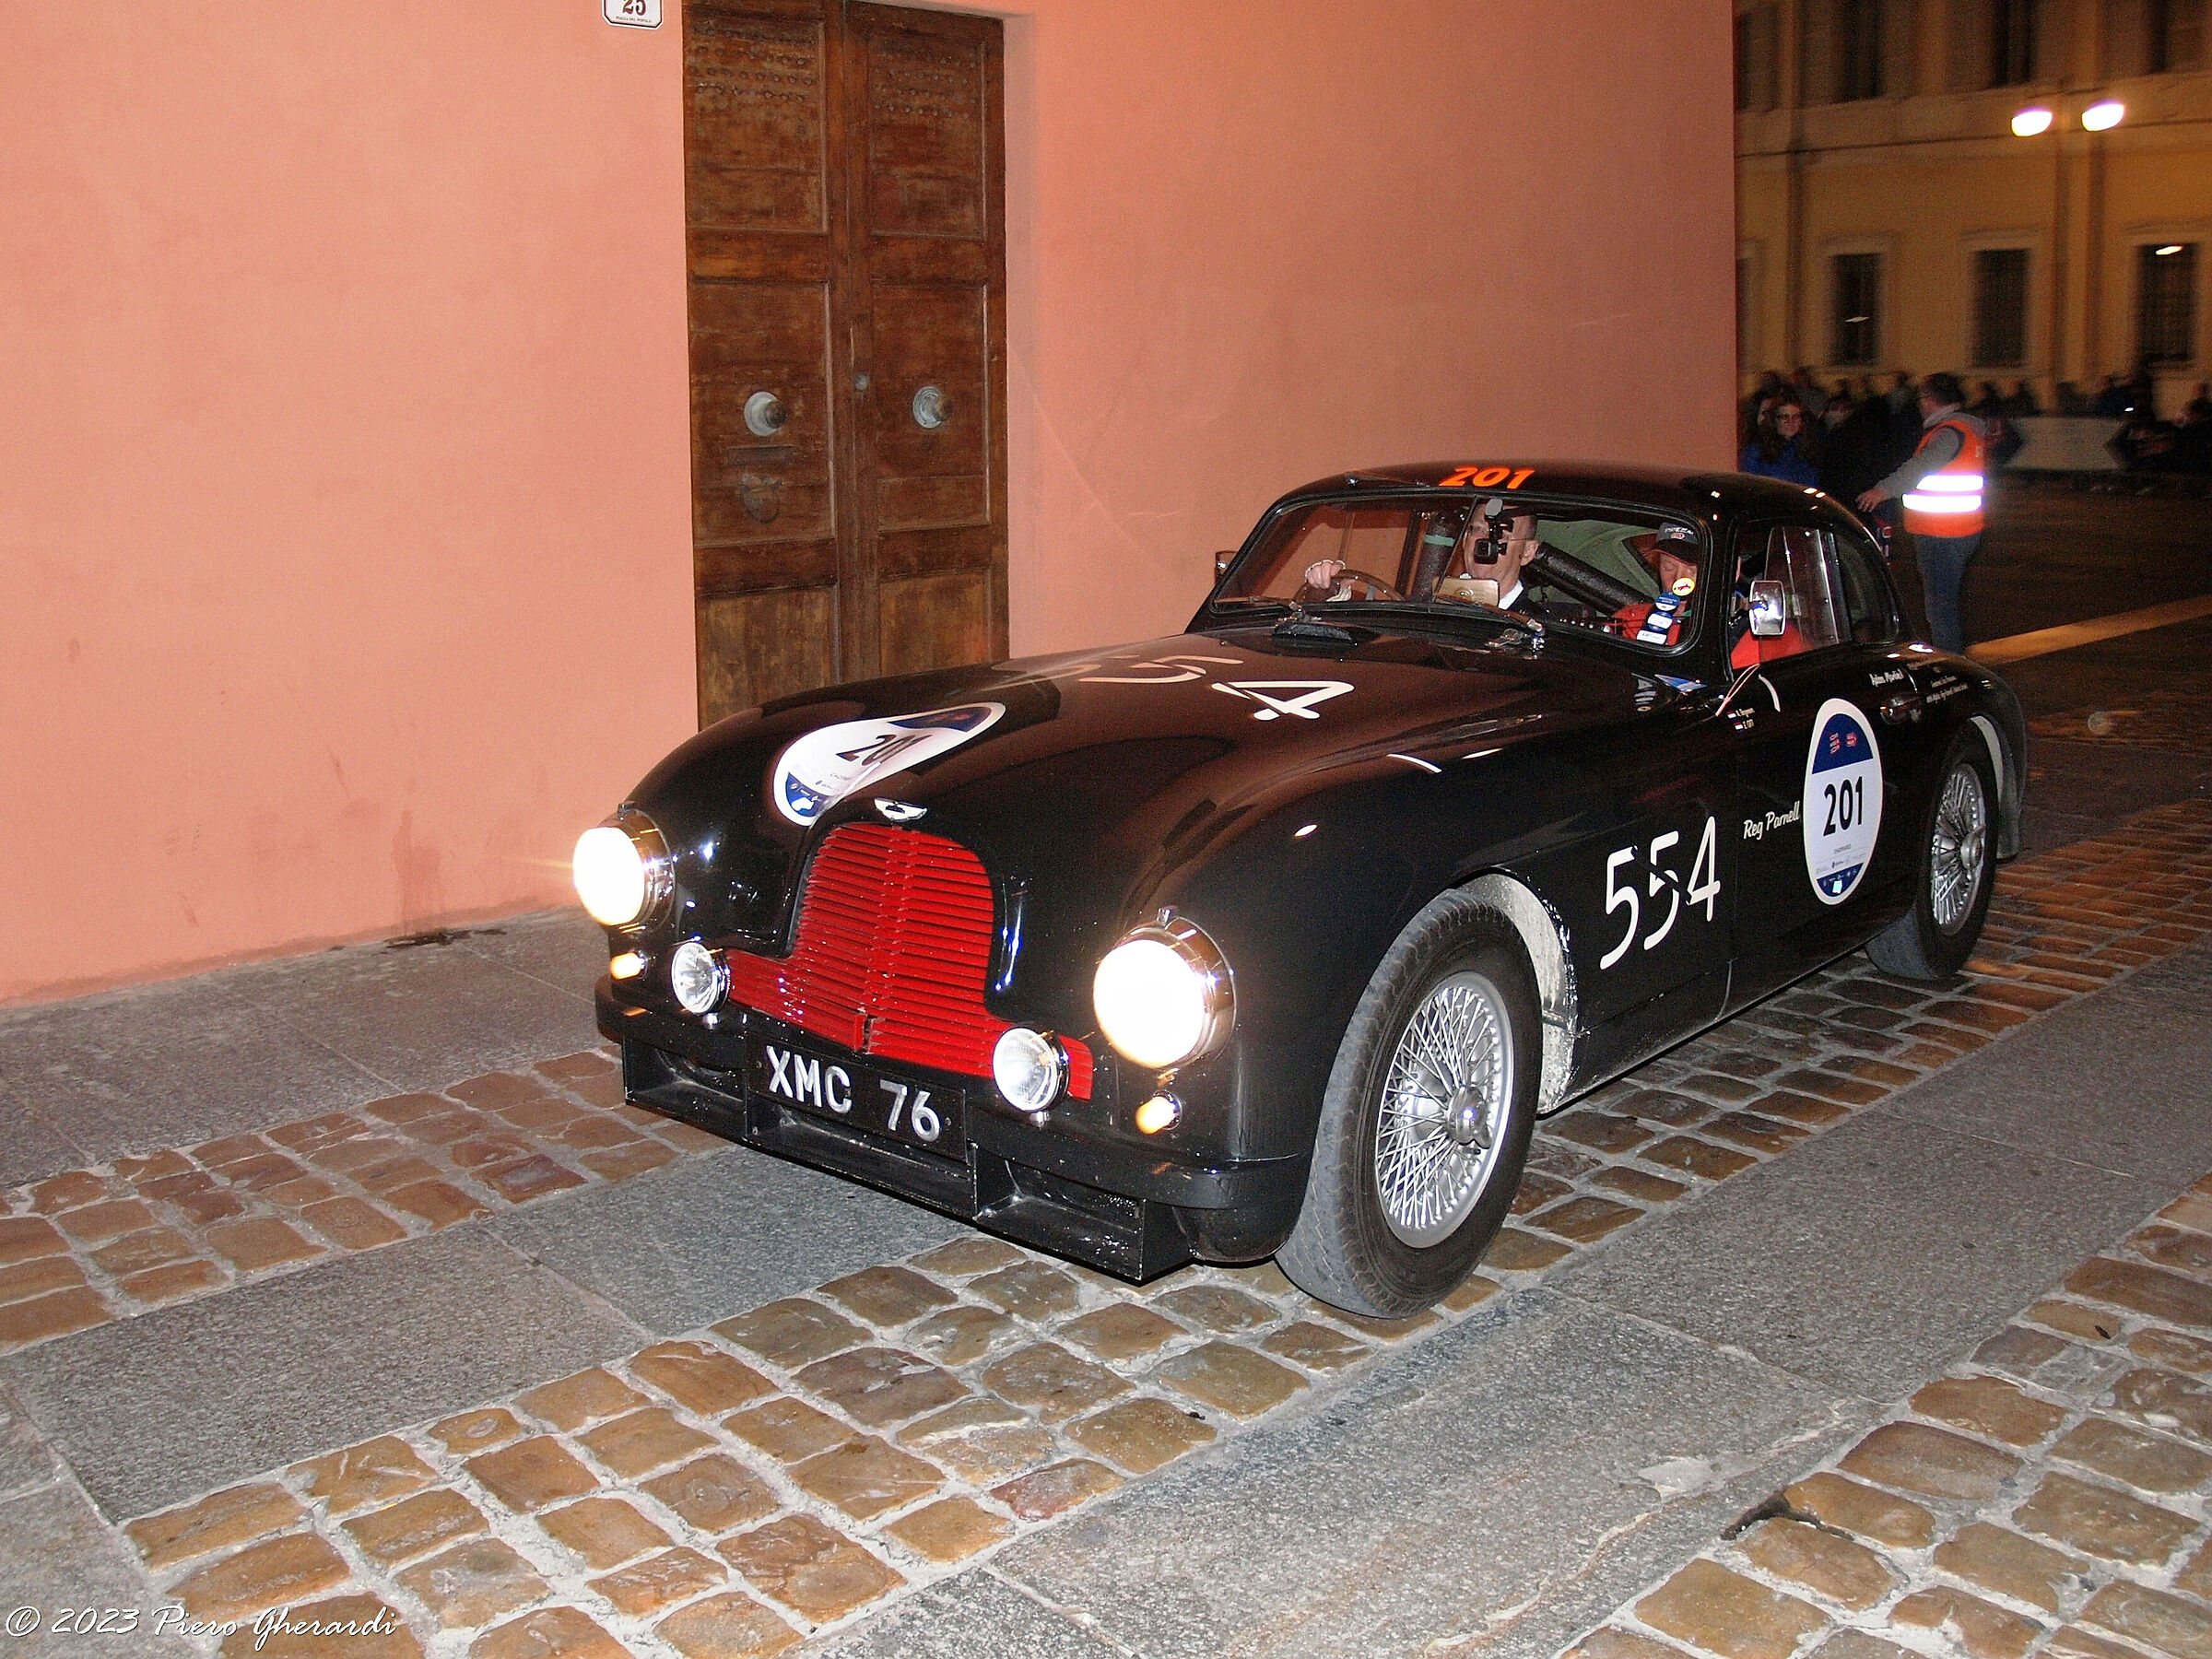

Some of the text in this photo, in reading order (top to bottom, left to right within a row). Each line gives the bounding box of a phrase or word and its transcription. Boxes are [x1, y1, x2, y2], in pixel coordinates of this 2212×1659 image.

[1438, 465, 1535, 489] 201
[1743, 800, 1801, 841] Reg Parnell
[1823, 776, 1863, 837] 201
[1599, 816, 1721, 971] 554
[766, 1045, 941, 1142] XMC 76
